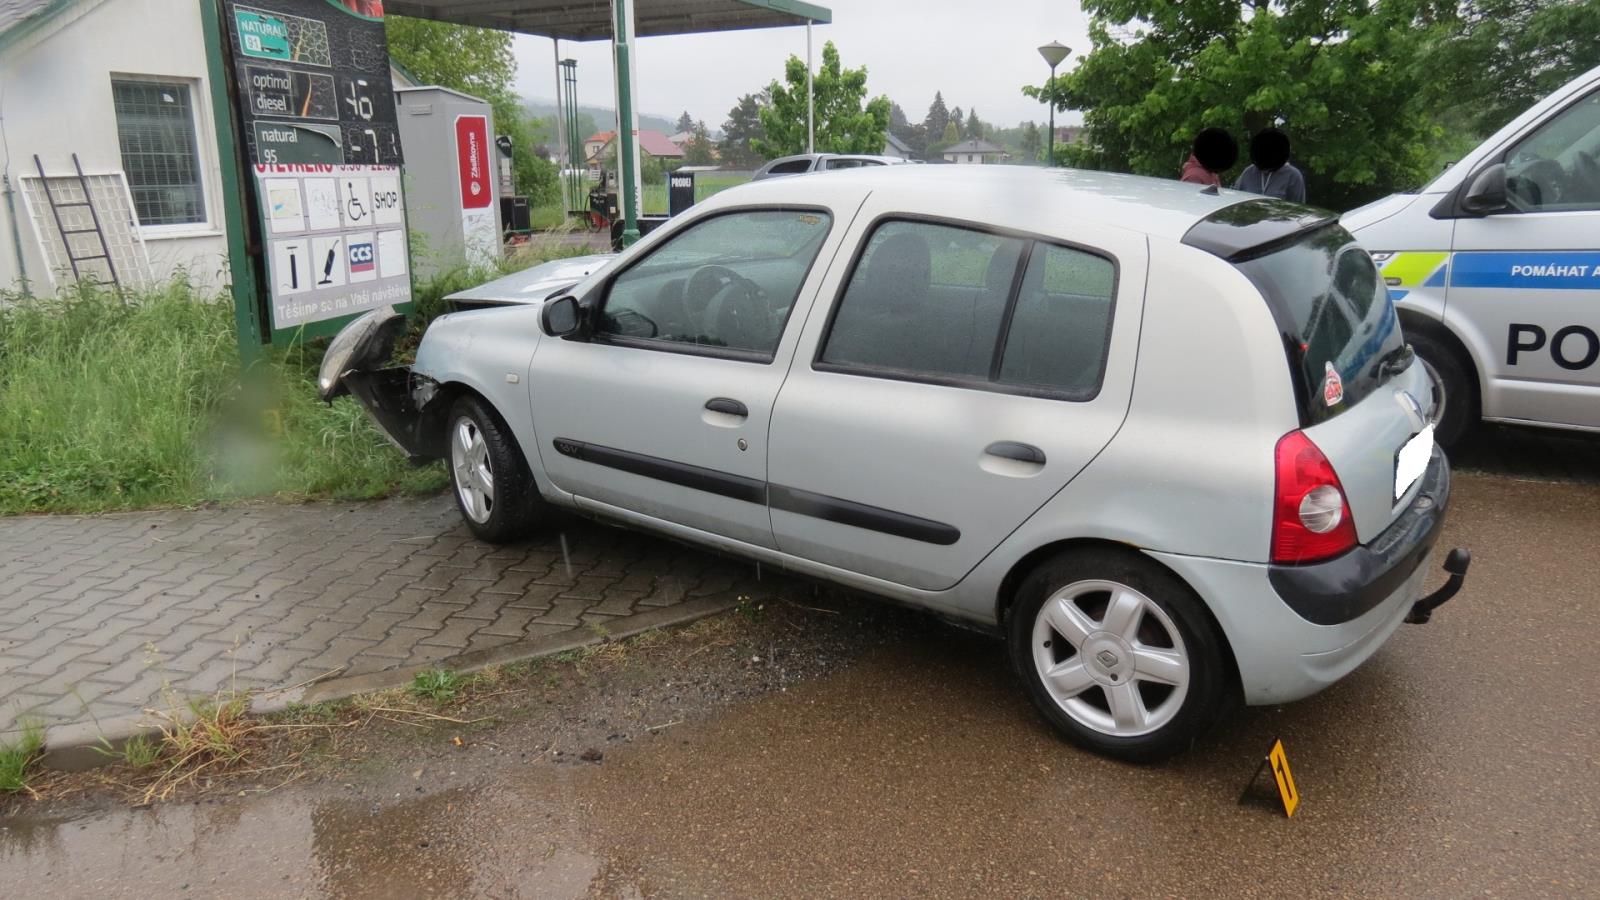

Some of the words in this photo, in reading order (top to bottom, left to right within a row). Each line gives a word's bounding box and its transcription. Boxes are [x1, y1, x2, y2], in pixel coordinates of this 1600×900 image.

[240, 20, 282, 36] NATURAL
[256, 92, 287, 111] diesel
[261, 128, 298, 143] natural
[264, 149, 278, 164] 95
[671, 177, 692, 188] PRODEJ
[374, 191, 397, 209] SHOP
[350, 246, 372, 262] CCS
[1511, 262, 1589, 277] POMÁHAT
[335, 298, 348, 309] na
[1506, 323, 1600, 371] PO
[1276, 753, 1293, 801] 1
